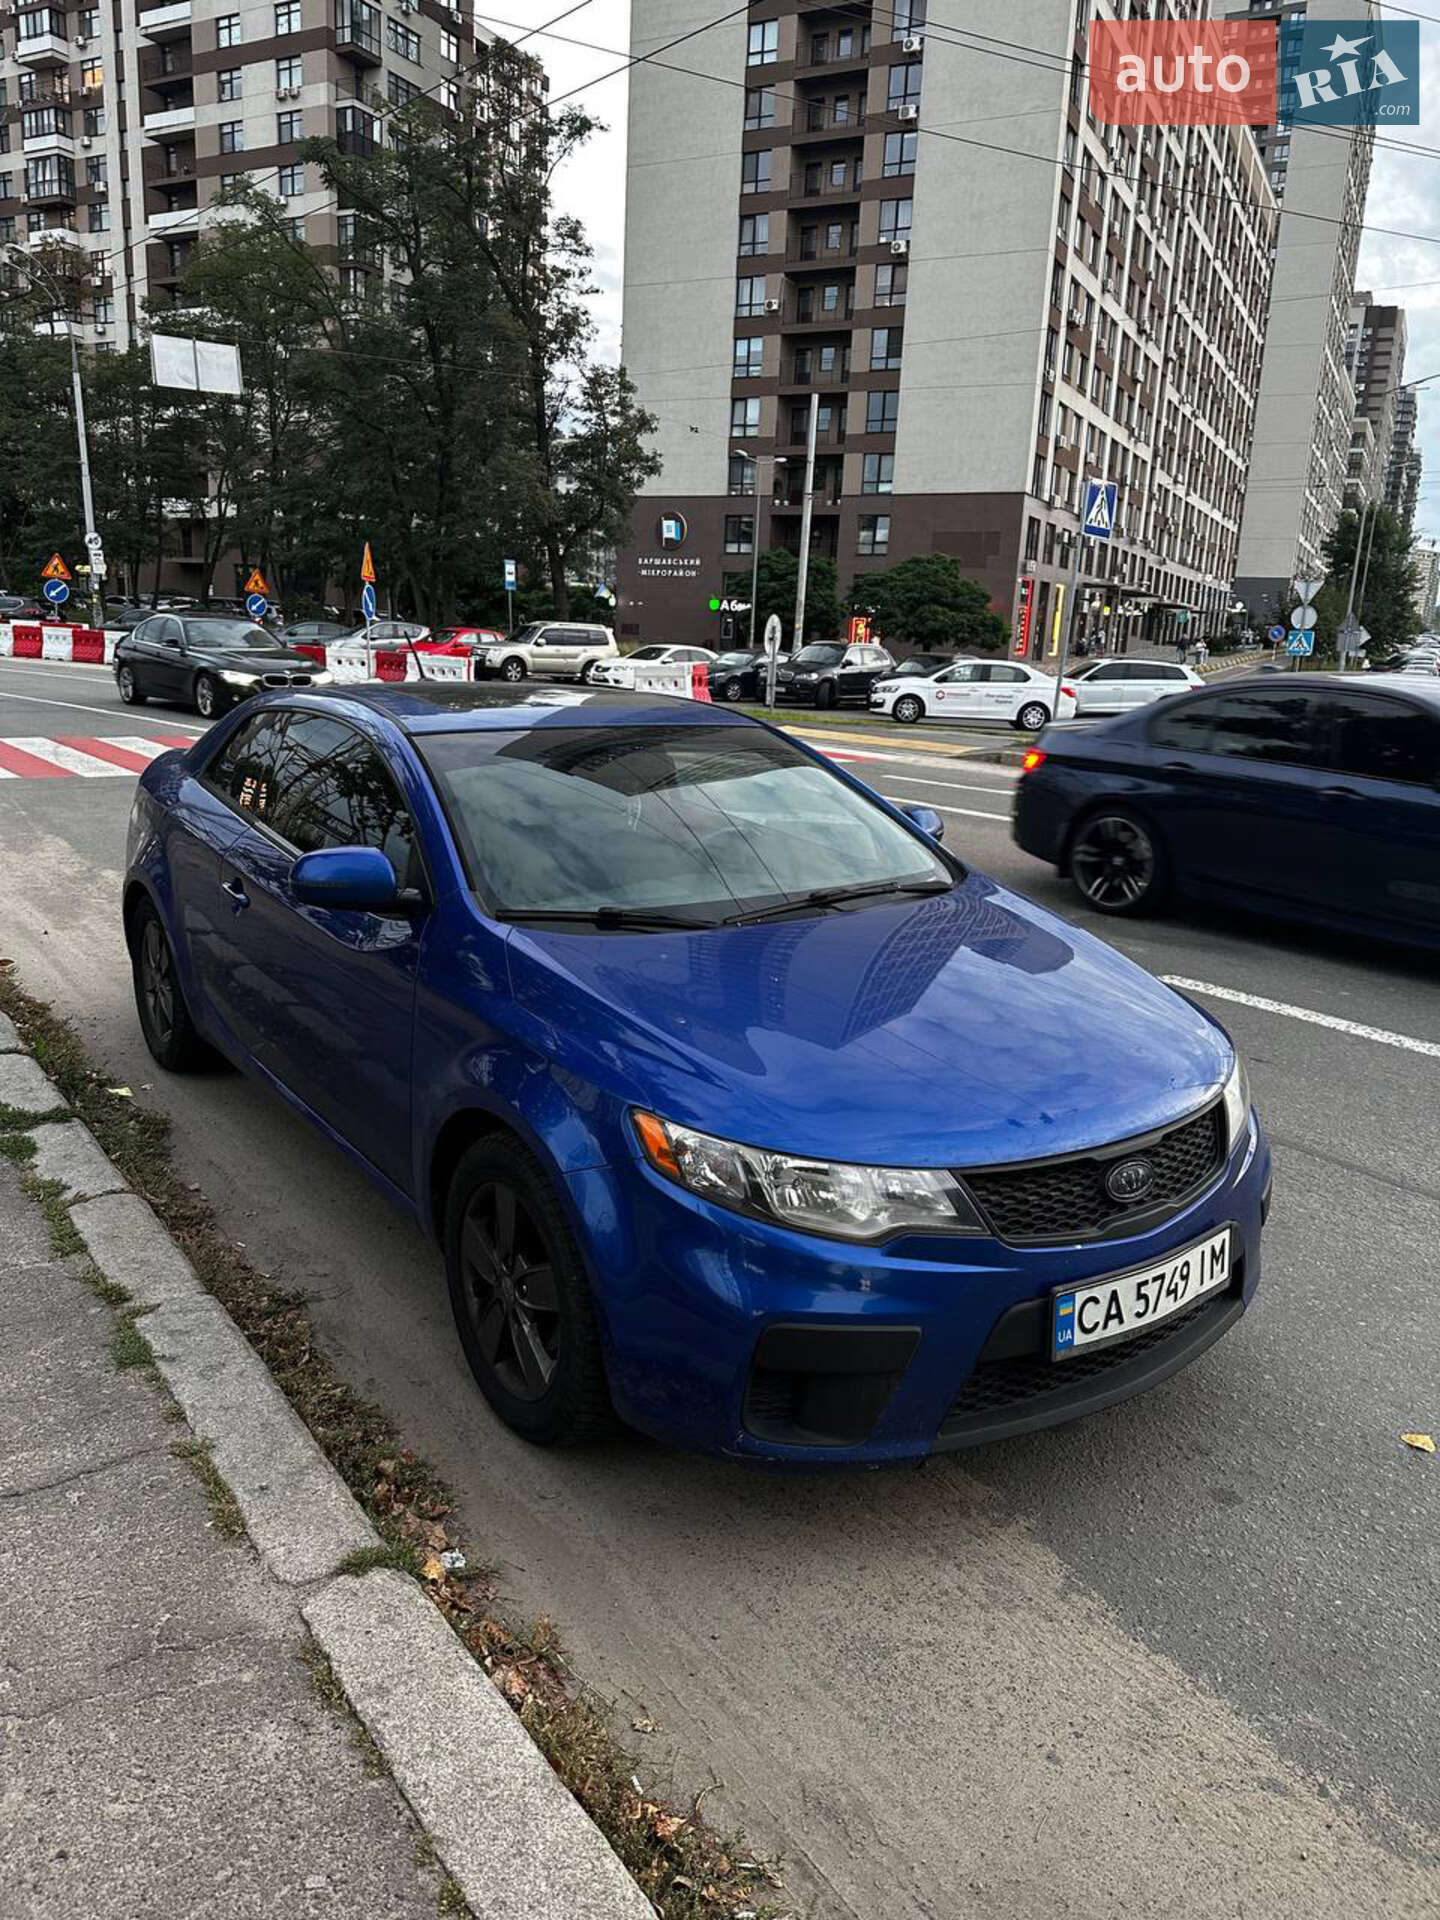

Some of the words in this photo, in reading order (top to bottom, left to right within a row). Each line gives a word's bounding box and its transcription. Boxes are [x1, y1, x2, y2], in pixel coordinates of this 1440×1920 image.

[1077, 1289, 1125, 1335] CA
[1134, 1260, 1191, 1319] 5749
[1199, 1237, 1227, 1287] IM
[1057, 1329, 1073, 1344] UA
